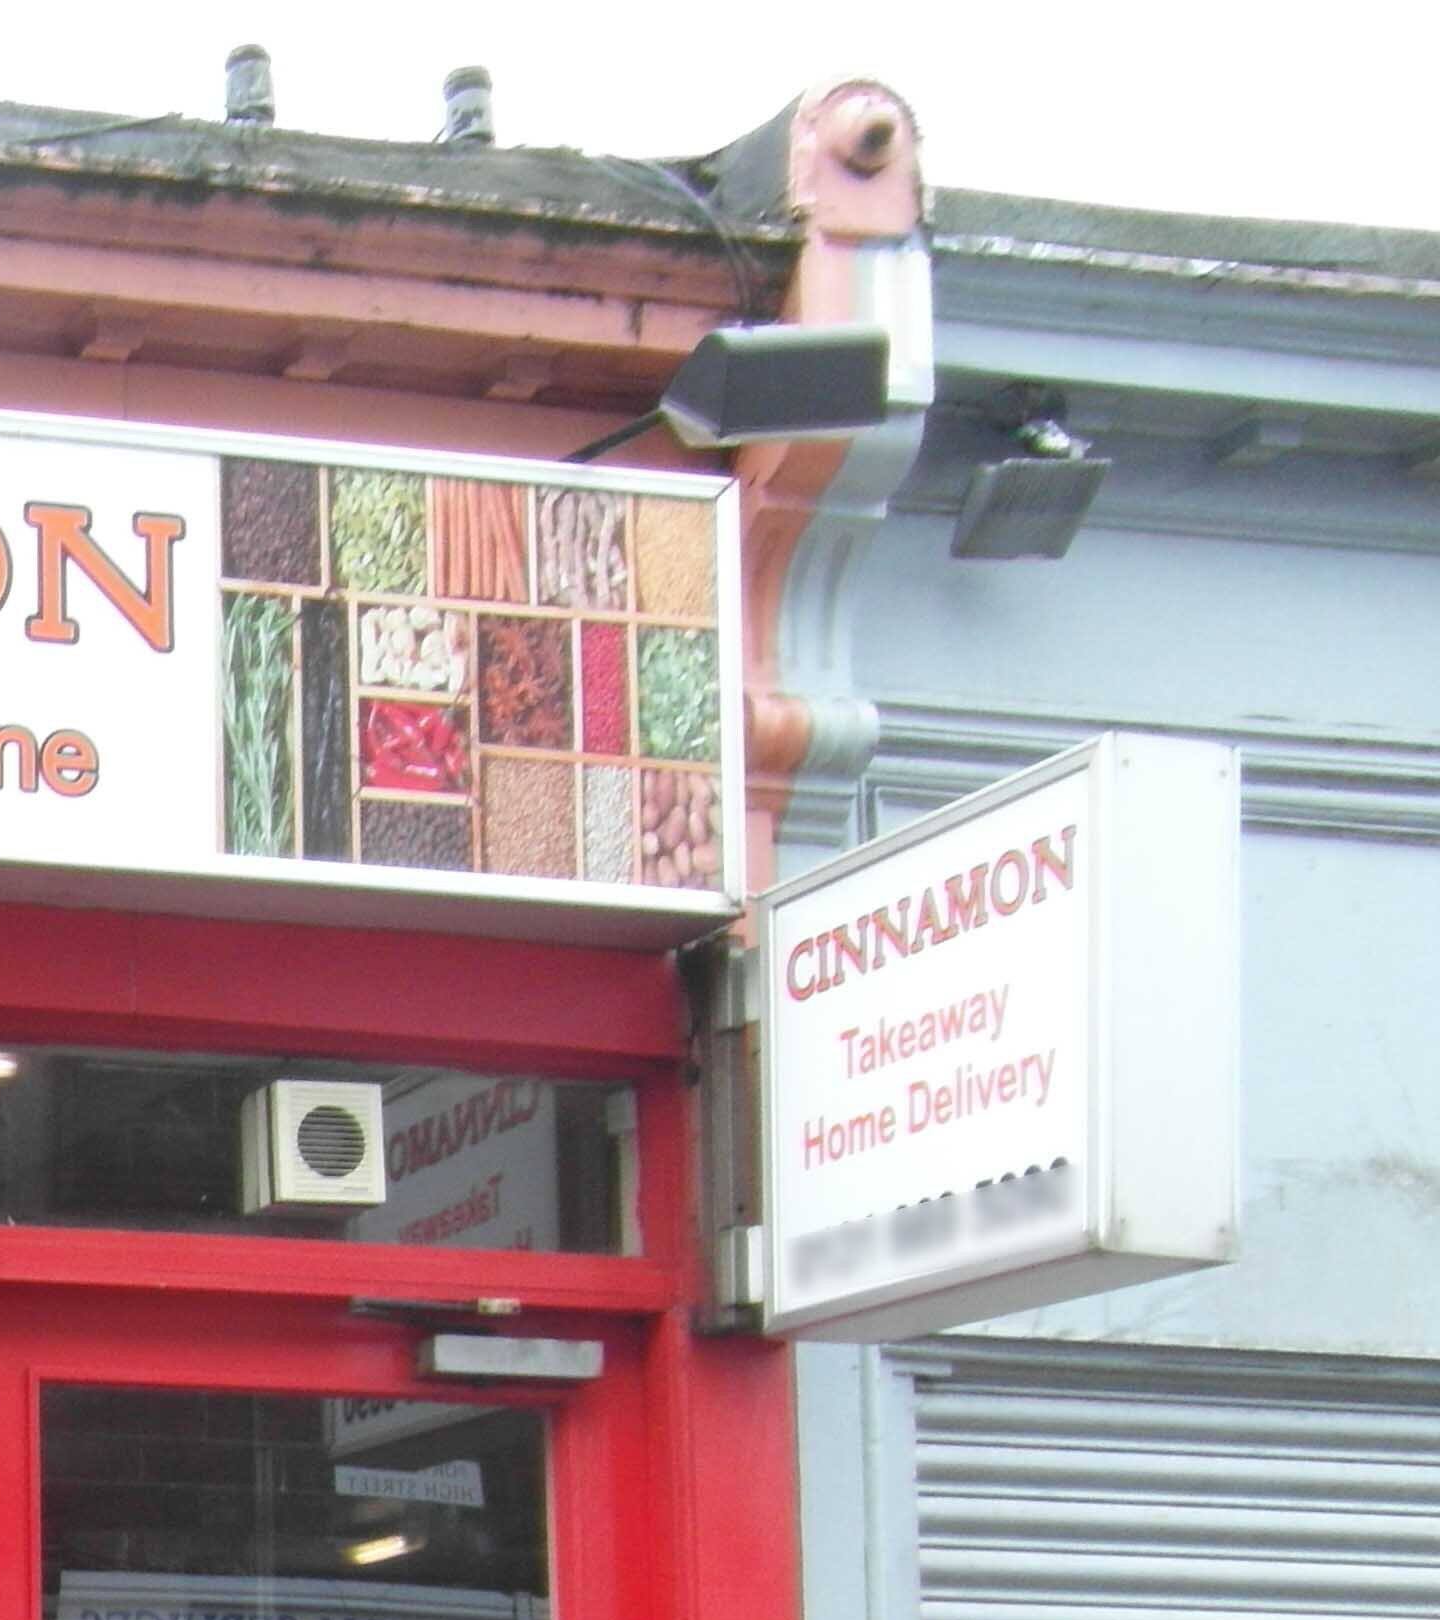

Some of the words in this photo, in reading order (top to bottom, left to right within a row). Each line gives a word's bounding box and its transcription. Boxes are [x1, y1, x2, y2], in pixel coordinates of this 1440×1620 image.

[785, 824, 1077, 1003] CINNAMON
[839, 983, 1010, 1080] Takeaway
[801, 1107, 897, 1171] Home
[907, 1047, 1057, 1137] Delivery
